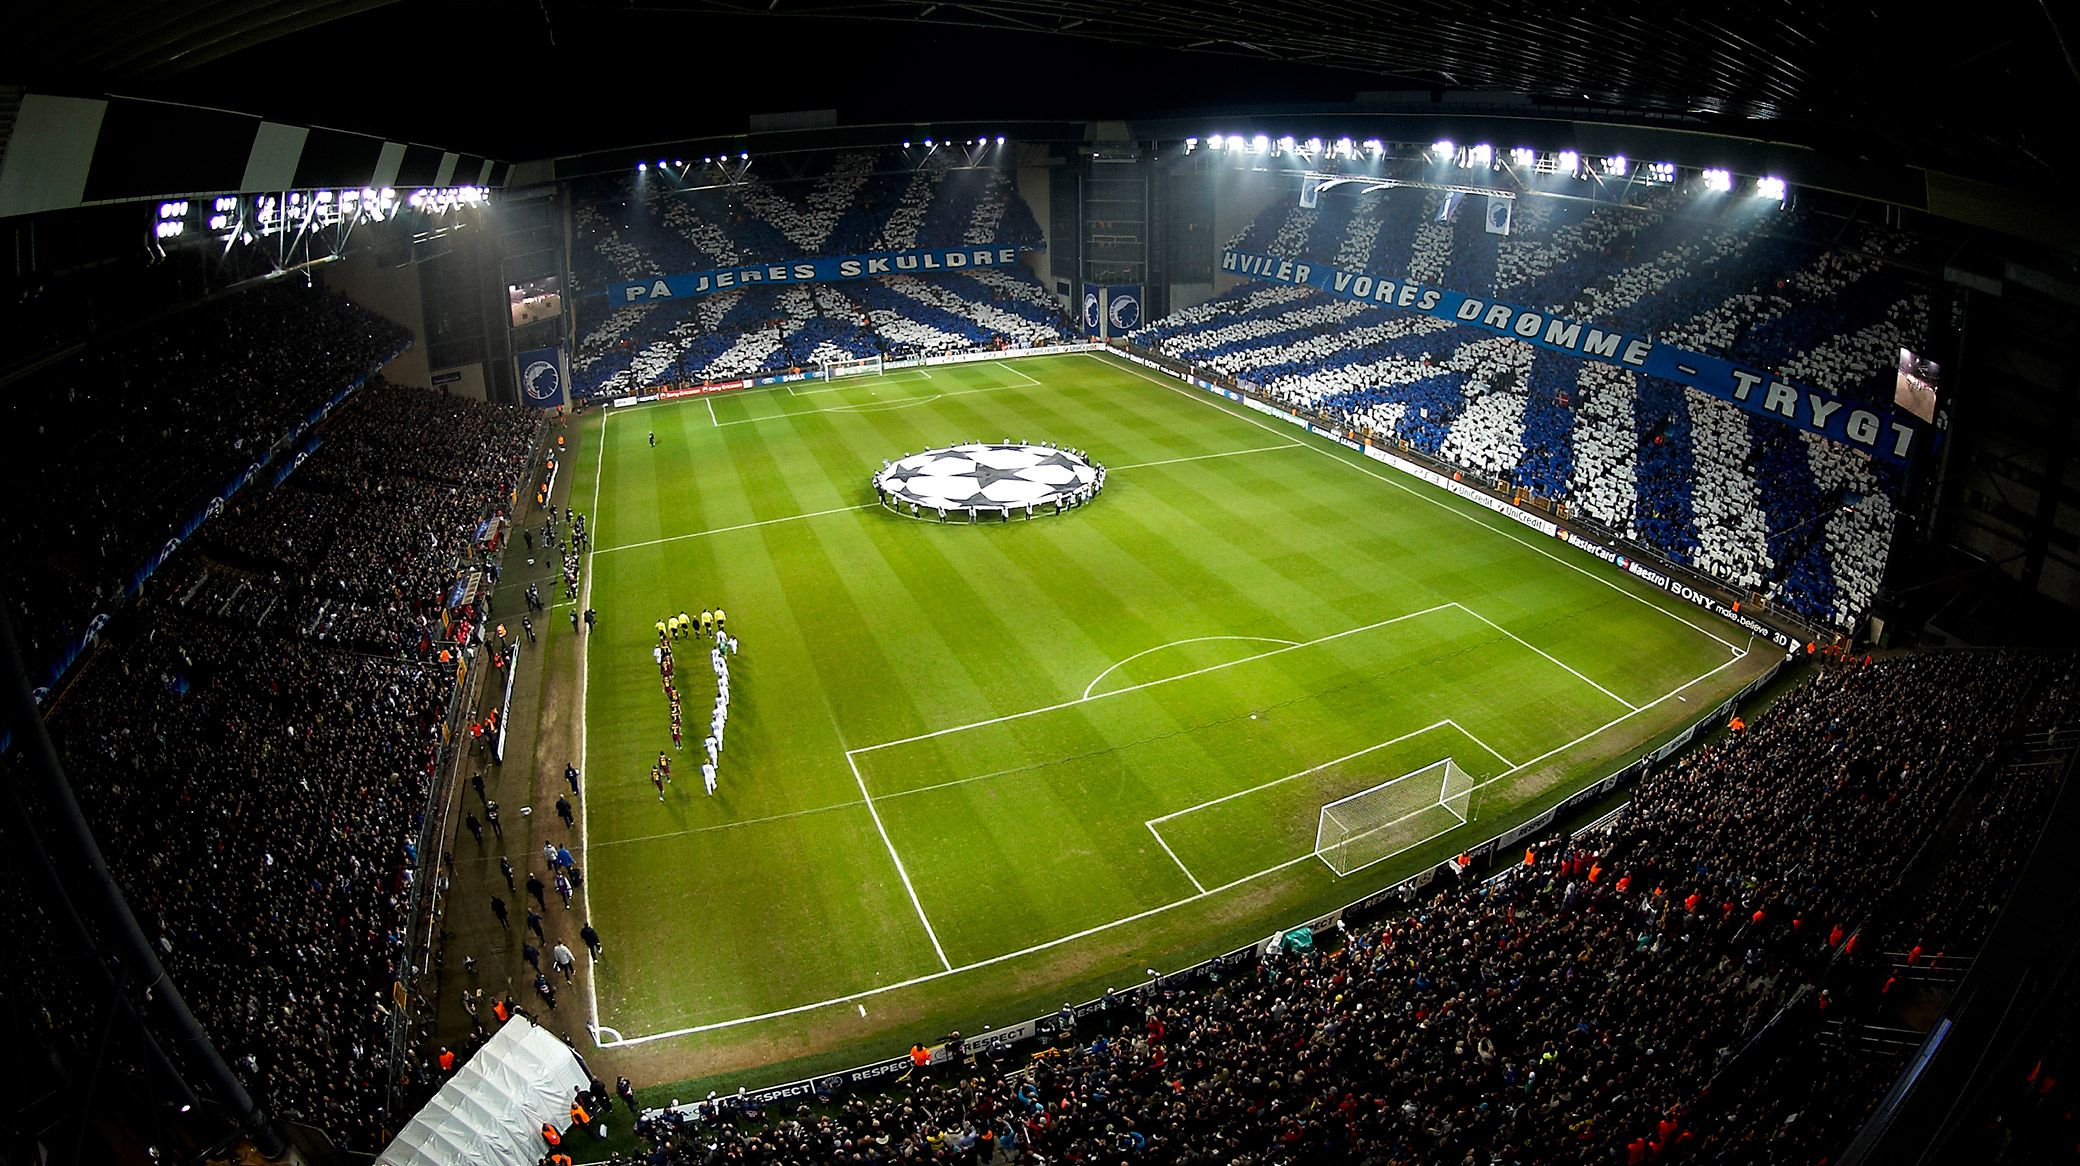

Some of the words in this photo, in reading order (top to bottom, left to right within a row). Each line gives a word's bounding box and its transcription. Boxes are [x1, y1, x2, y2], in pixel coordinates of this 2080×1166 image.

[696, 263, 817, 292] JERES
[839, 248, 1017, 277] SKULDRE
[1222, 251, 1312, 284] HVILER
[1333, 271, 1441, 312] VORES
[1456, 297, 1654, 367] DRØMME
[1458, 486, 1493, 508] UniCredit
[1505, 503, 1543, 530] UniCredit
[1567, 533, 1616, 564] MasterCard
[1628, 560, 1665, 587] Maestro
[1670, 581, 1716, 611] SONY
[1772, 631, 1788, 646] 3D
[961, 1027, 1026, 1052] RESPECT
